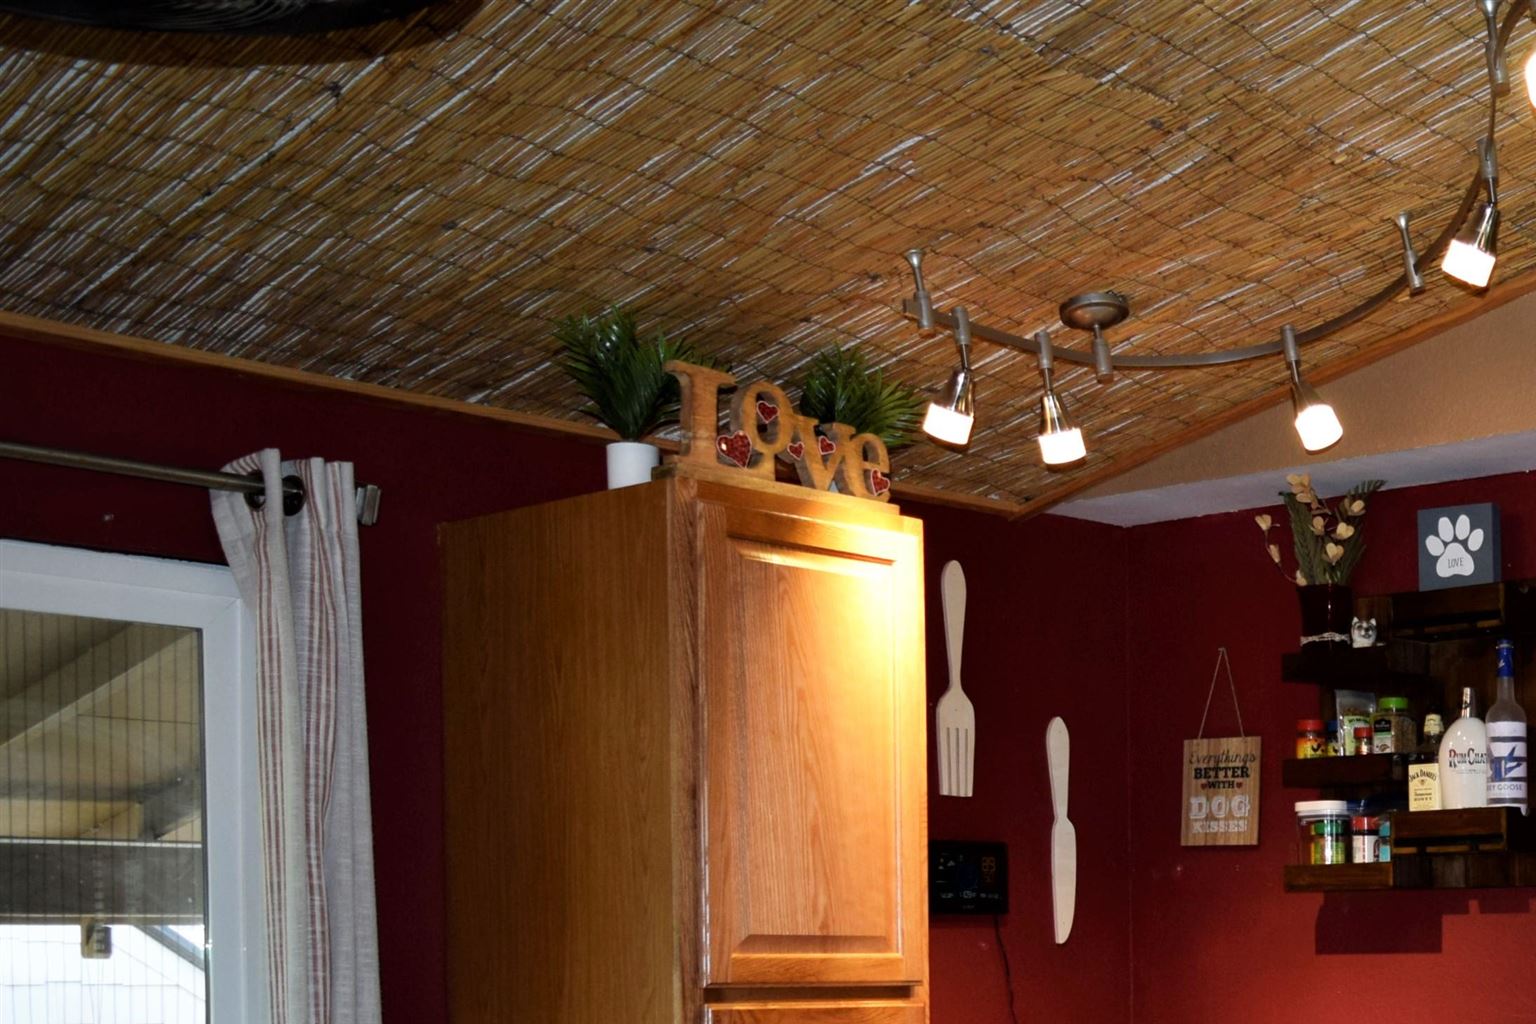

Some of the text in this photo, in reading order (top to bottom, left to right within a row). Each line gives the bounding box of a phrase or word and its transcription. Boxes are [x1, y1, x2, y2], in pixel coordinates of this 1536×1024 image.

[1447, 557, 1466, 569] LOVE
[1194, 766, 1250, 779] BETTER
[1208, 780, 1235, 789] WITH
[1497, 783, 1522, 791] GOOSE
[1190, 795, 1251, 820] DOG
[1192, 820, 1248, 834] KISSES
